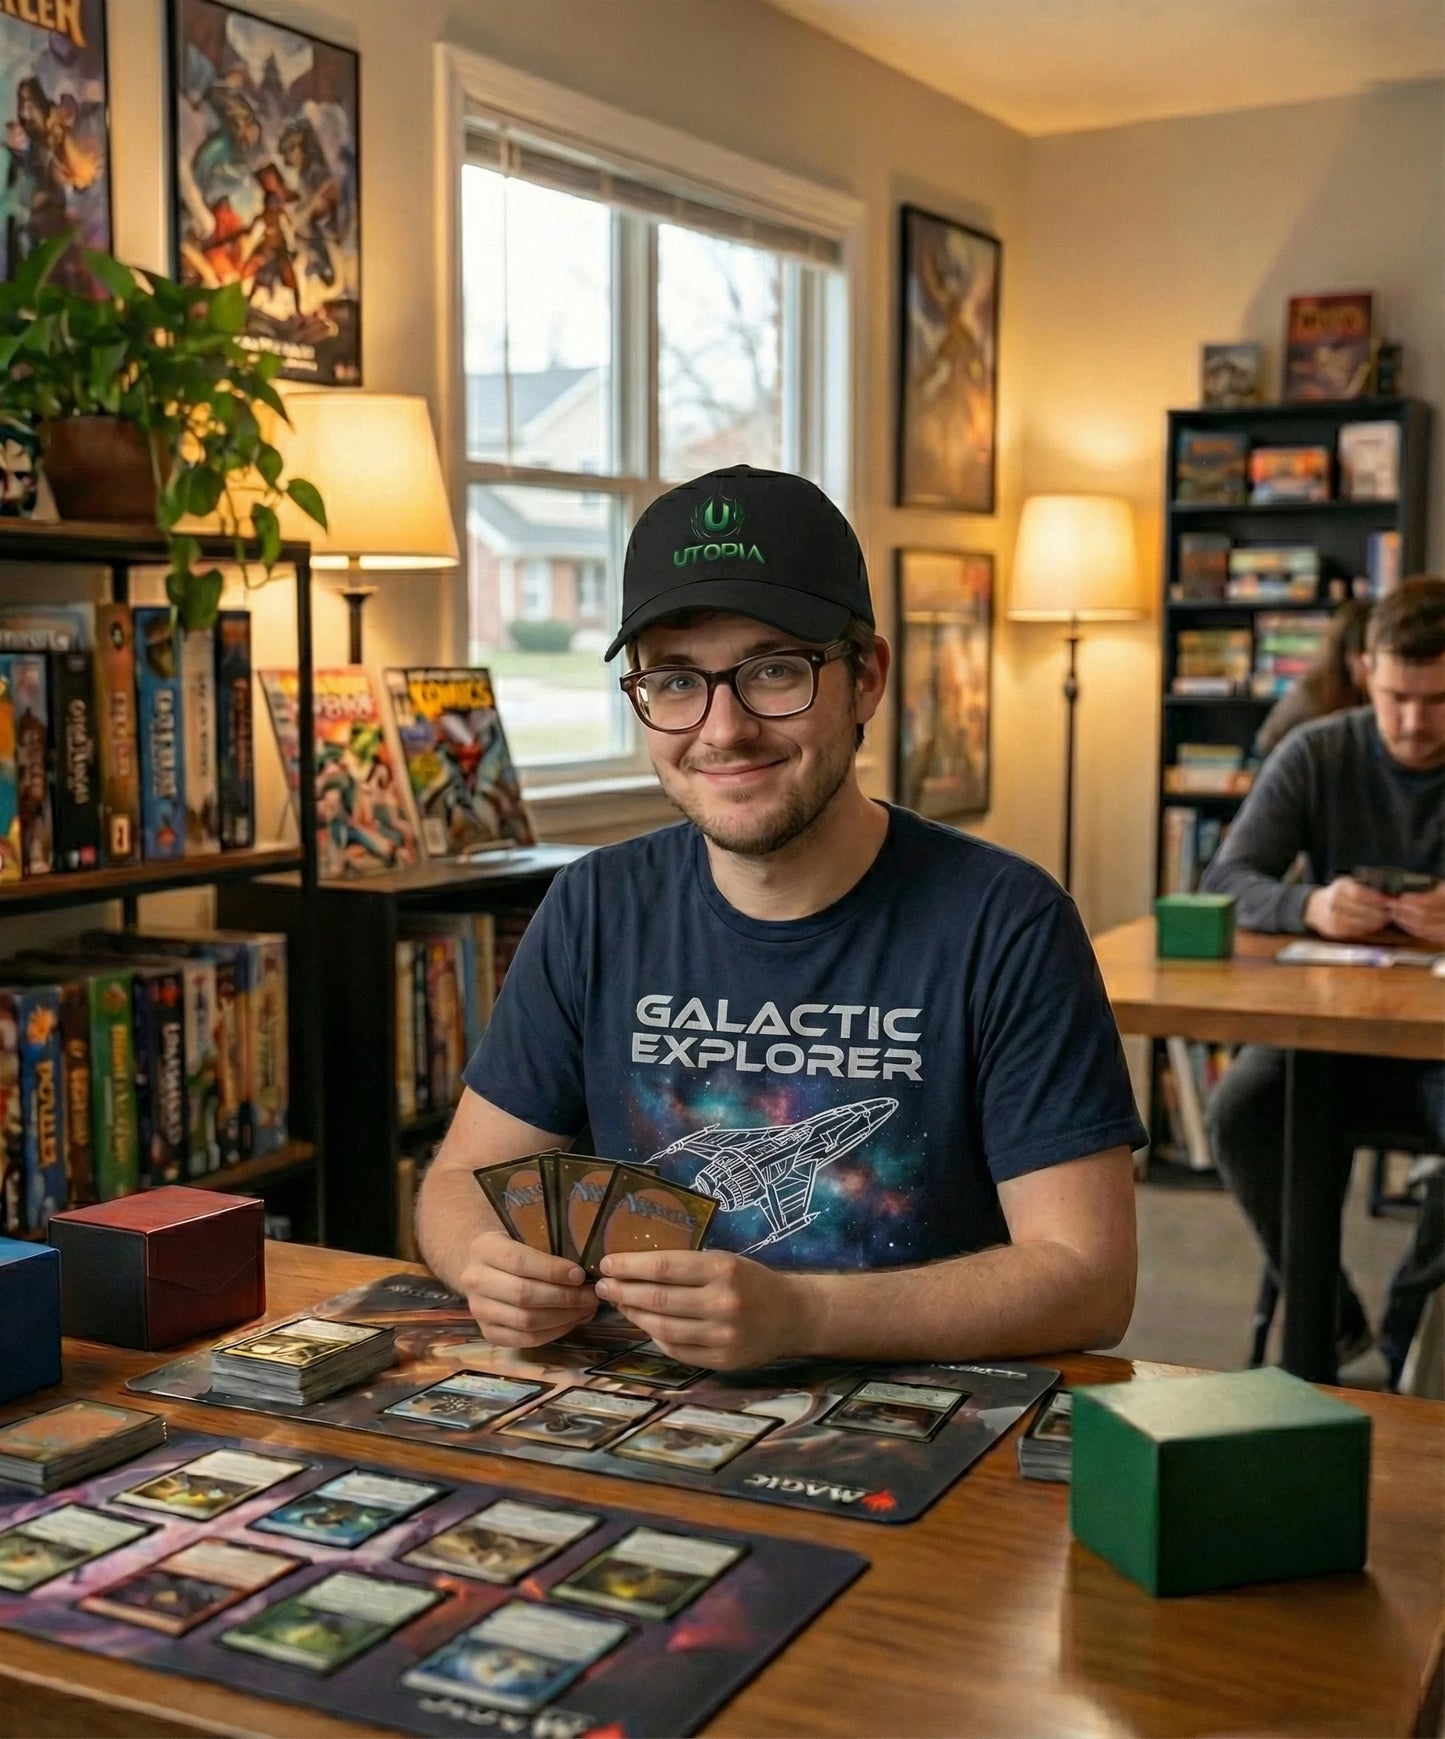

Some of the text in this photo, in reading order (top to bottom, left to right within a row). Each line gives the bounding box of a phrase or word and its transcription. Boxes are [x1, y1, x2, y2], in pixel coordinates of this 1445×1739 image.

[673, 542, 766, 568] UTOPIA
[636, 994, 923, 1042] GALACTIC
[631, 1031, 924, 1082] EXPLORER
